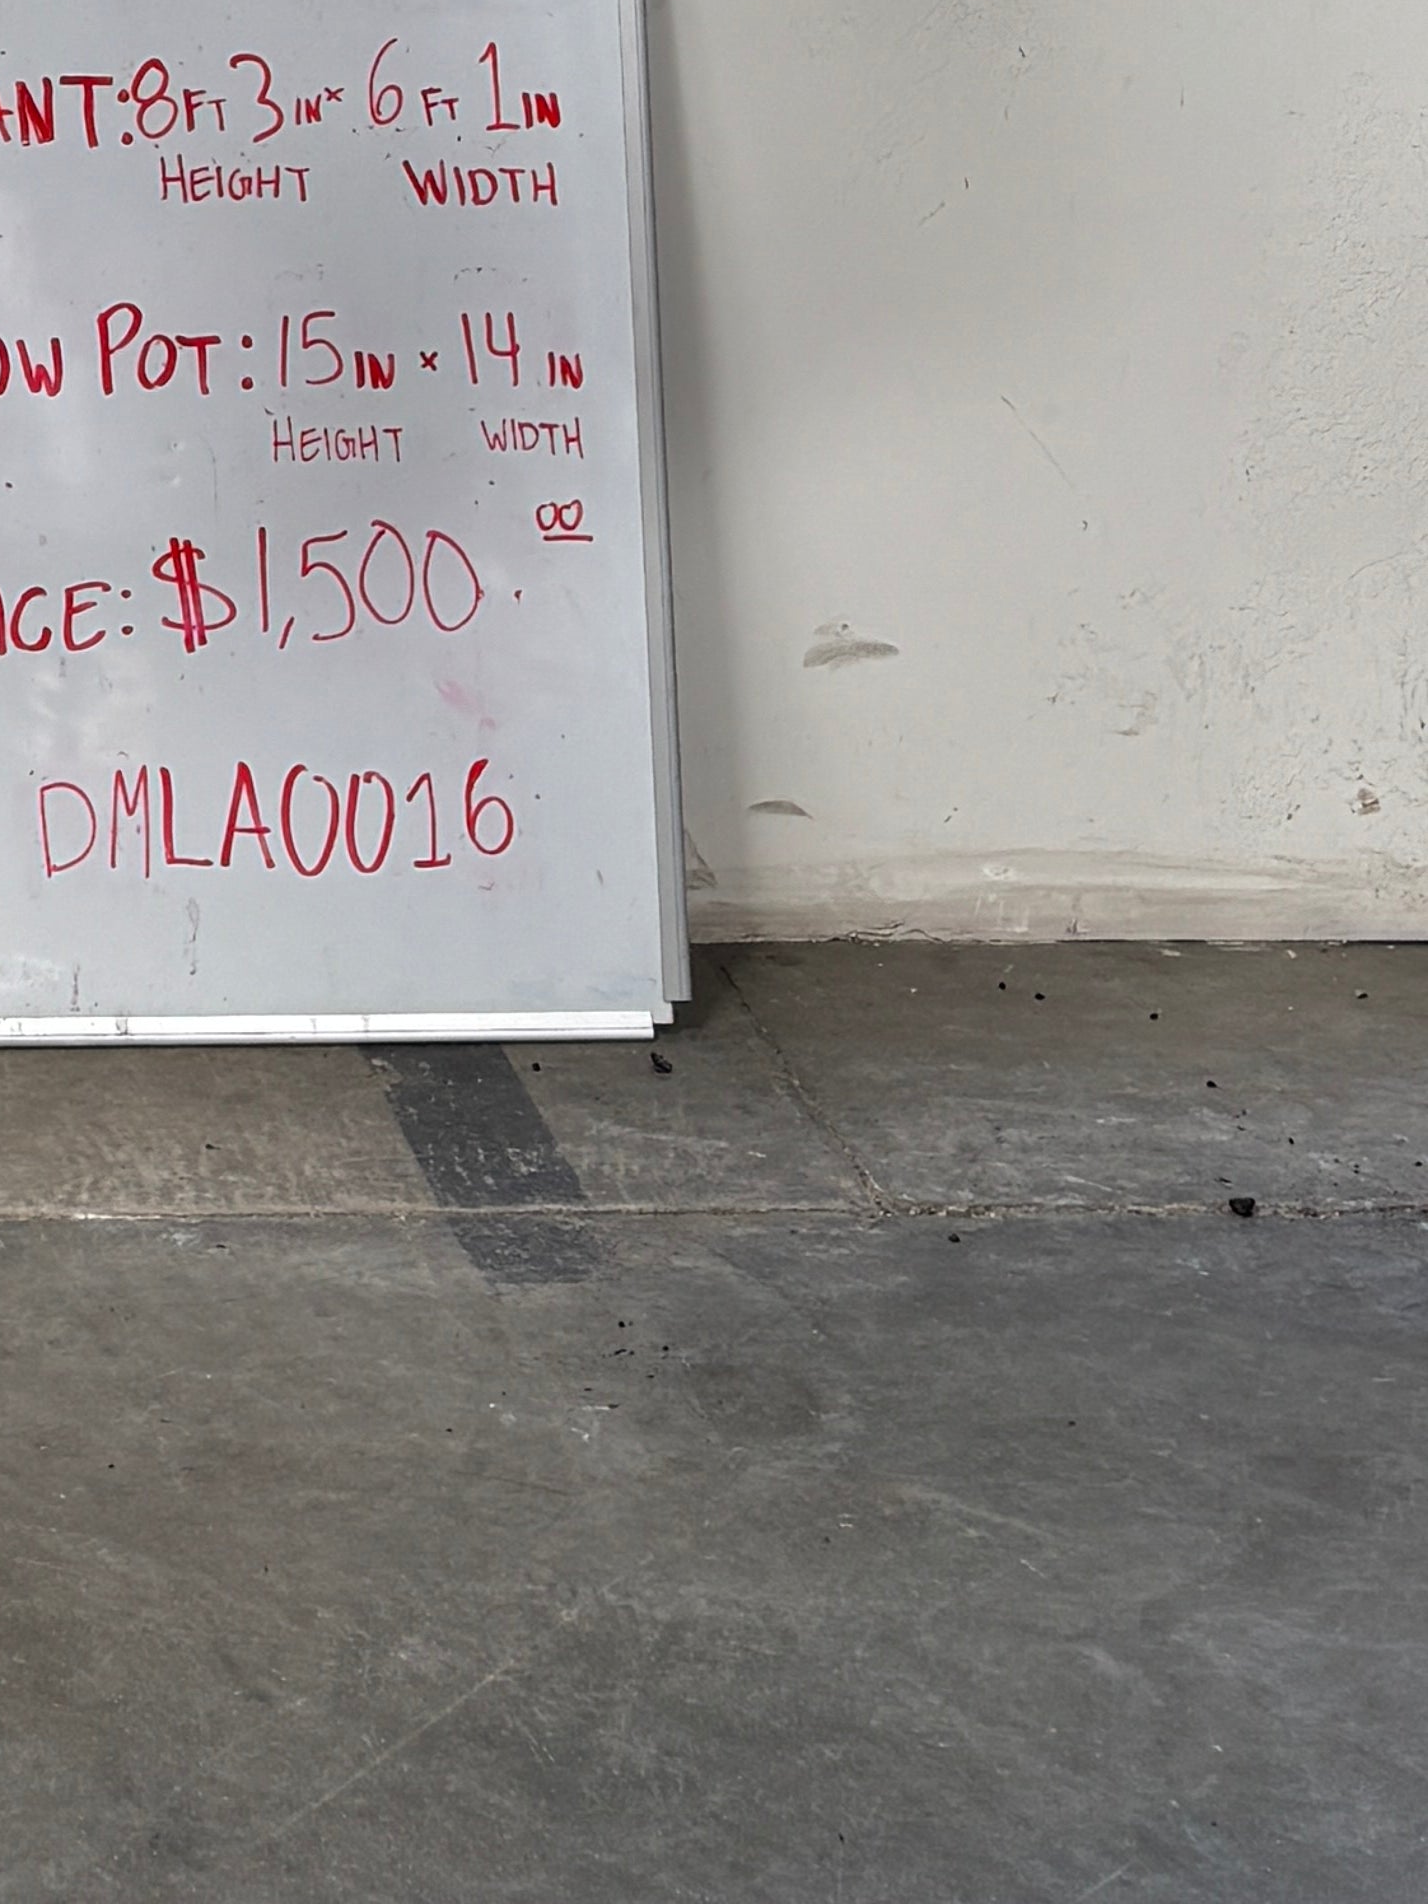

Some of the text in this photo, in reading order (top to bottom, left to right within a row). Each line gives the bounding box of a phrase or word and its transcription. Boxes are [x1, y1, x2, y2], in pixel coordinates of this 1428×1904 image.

[180, 88, 225, 134] FT
[227, 52, 286, 145] 3
[292, 94, 323, 127] IN
[367, 37, 405, 127] 6
[418, 86, 458, 126] FT
[478, 40, 520, 132] 1
[520, 91, 563, 131] IN
[159, 158, 559, 209] HEIGHT WIDTH
[94, 301, 255, 398] POT:
[277, 309, 346, 387] 15
[352, 350, 397, 392] IN
[459, 311, 522, 387] 14
[545, 351, 585, 392] IN
[271, 417, 584, 463] HEIGHT WIDTH
[36, 756, 516, 879] DMLA0016
